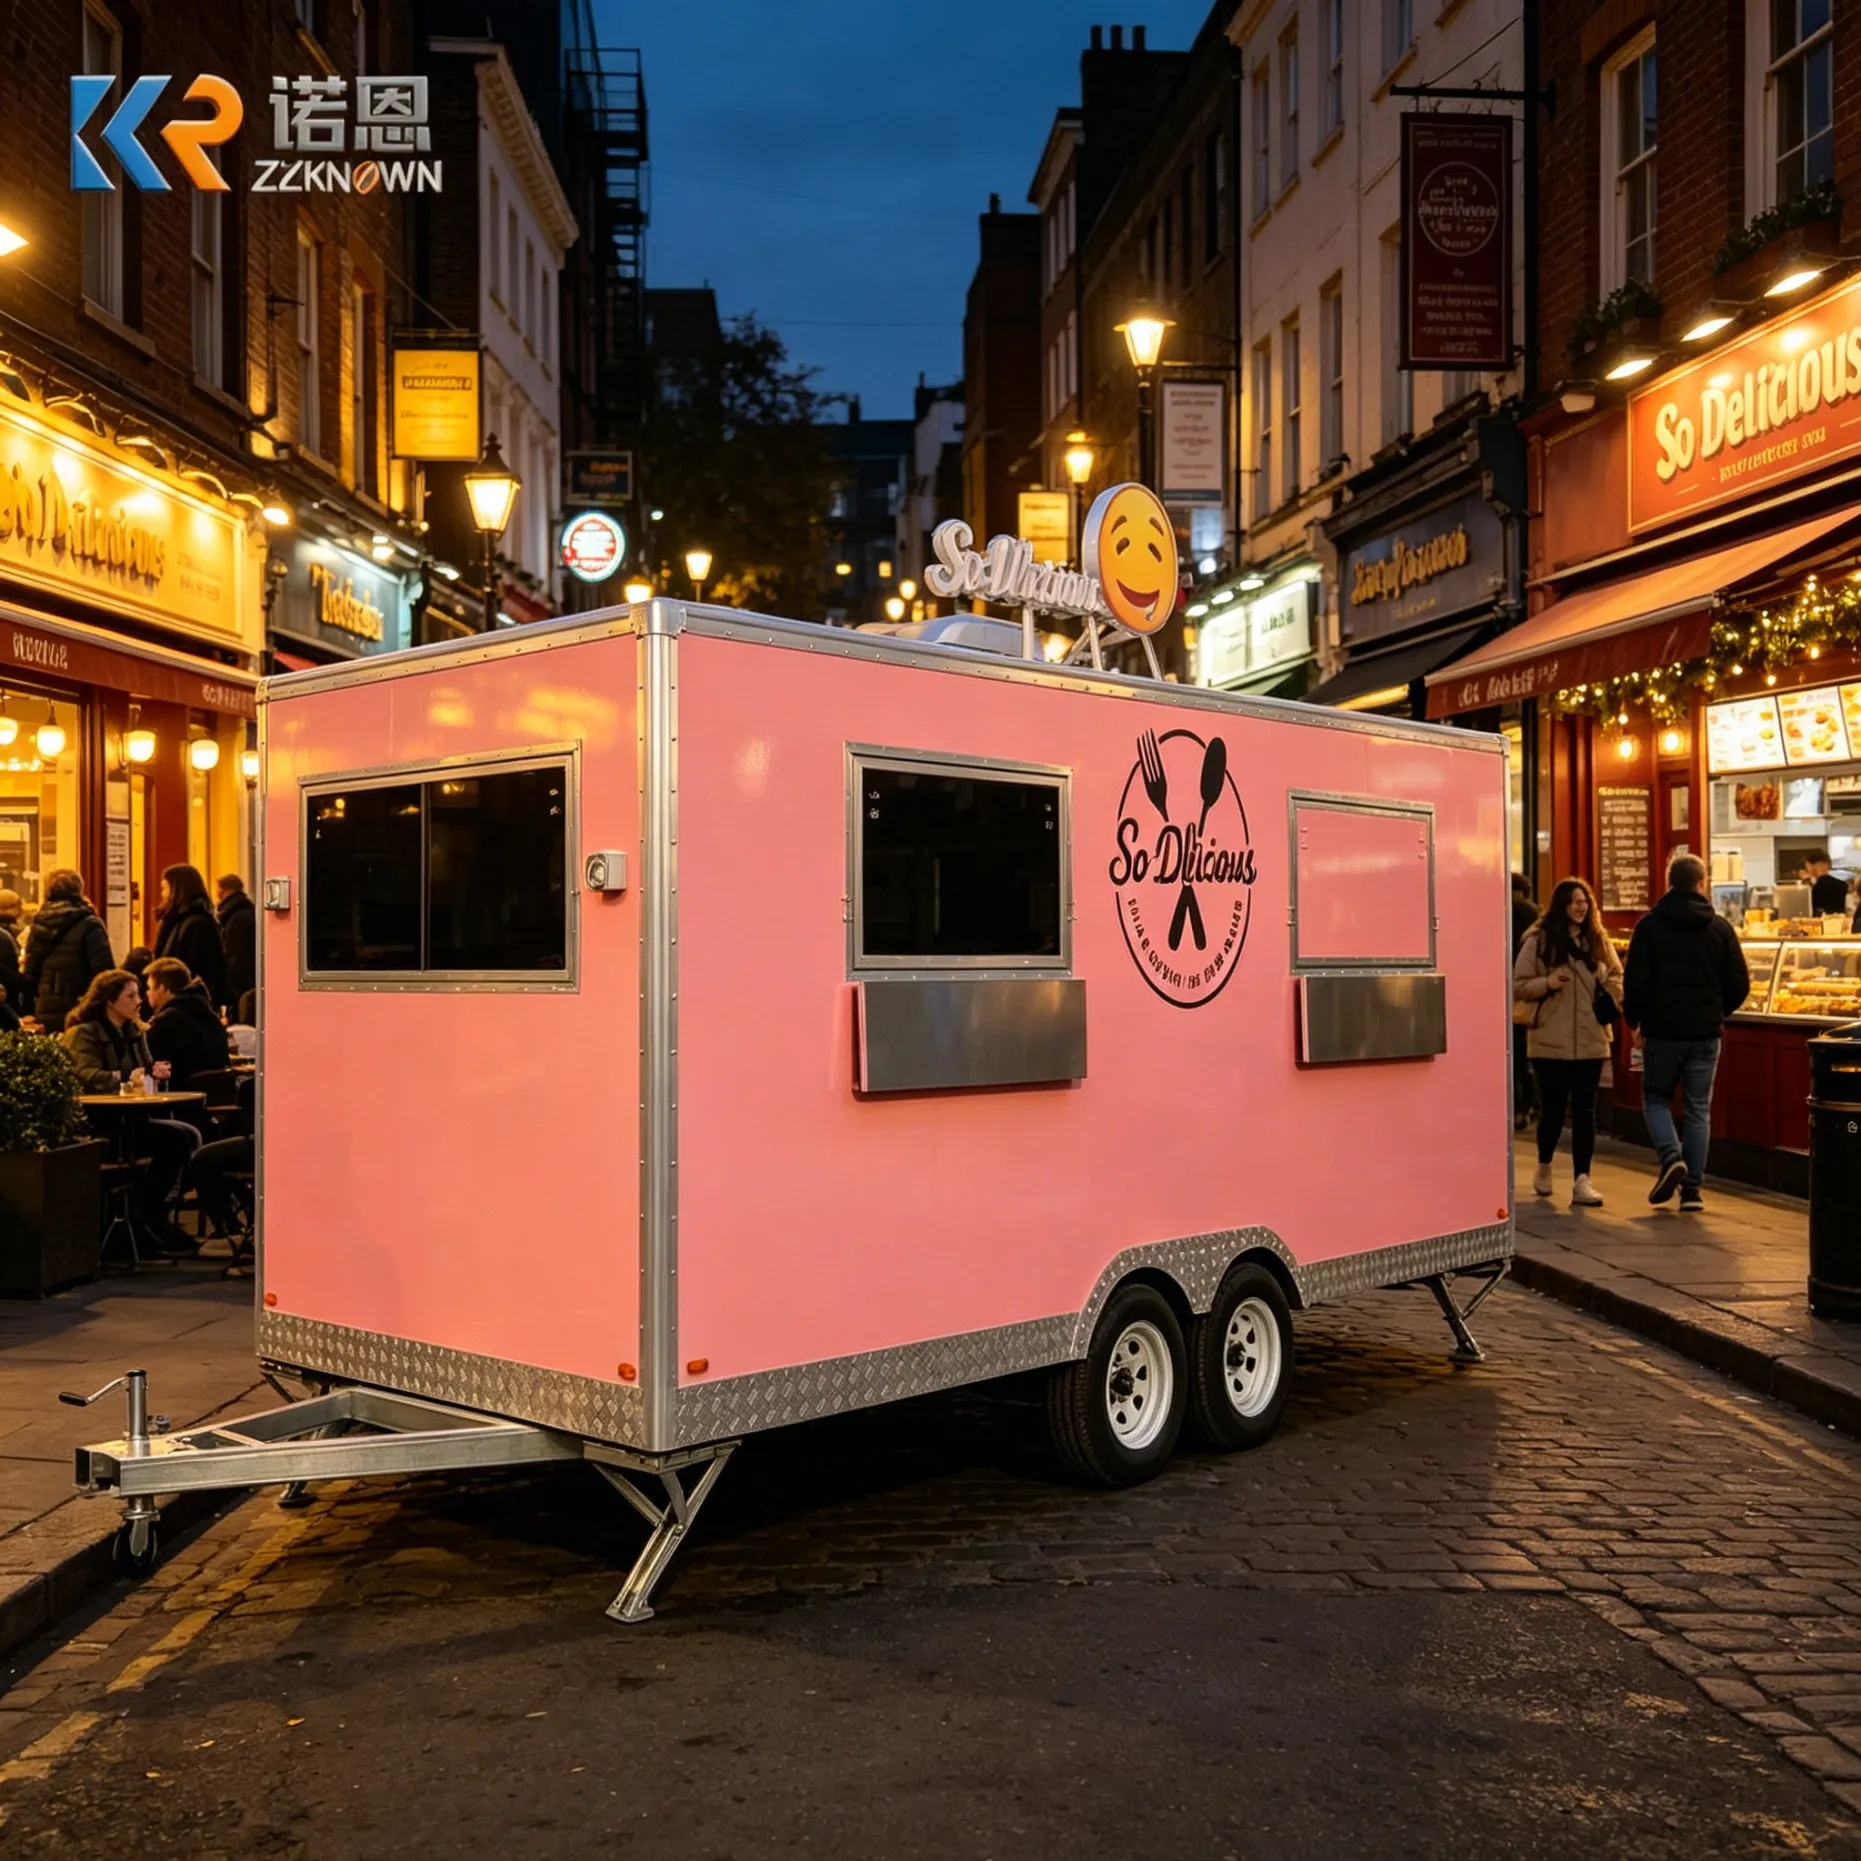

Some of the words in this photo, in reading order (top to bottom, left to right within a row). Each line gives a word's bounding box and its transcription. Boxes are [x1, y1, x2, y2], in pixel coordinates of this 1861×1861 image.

[1655, 402, 1696, 481] So
[1701, 325, 1861, 458] Delicious
[924, 518, 984, 597] So
[1109, 817, 1150, 886] So
